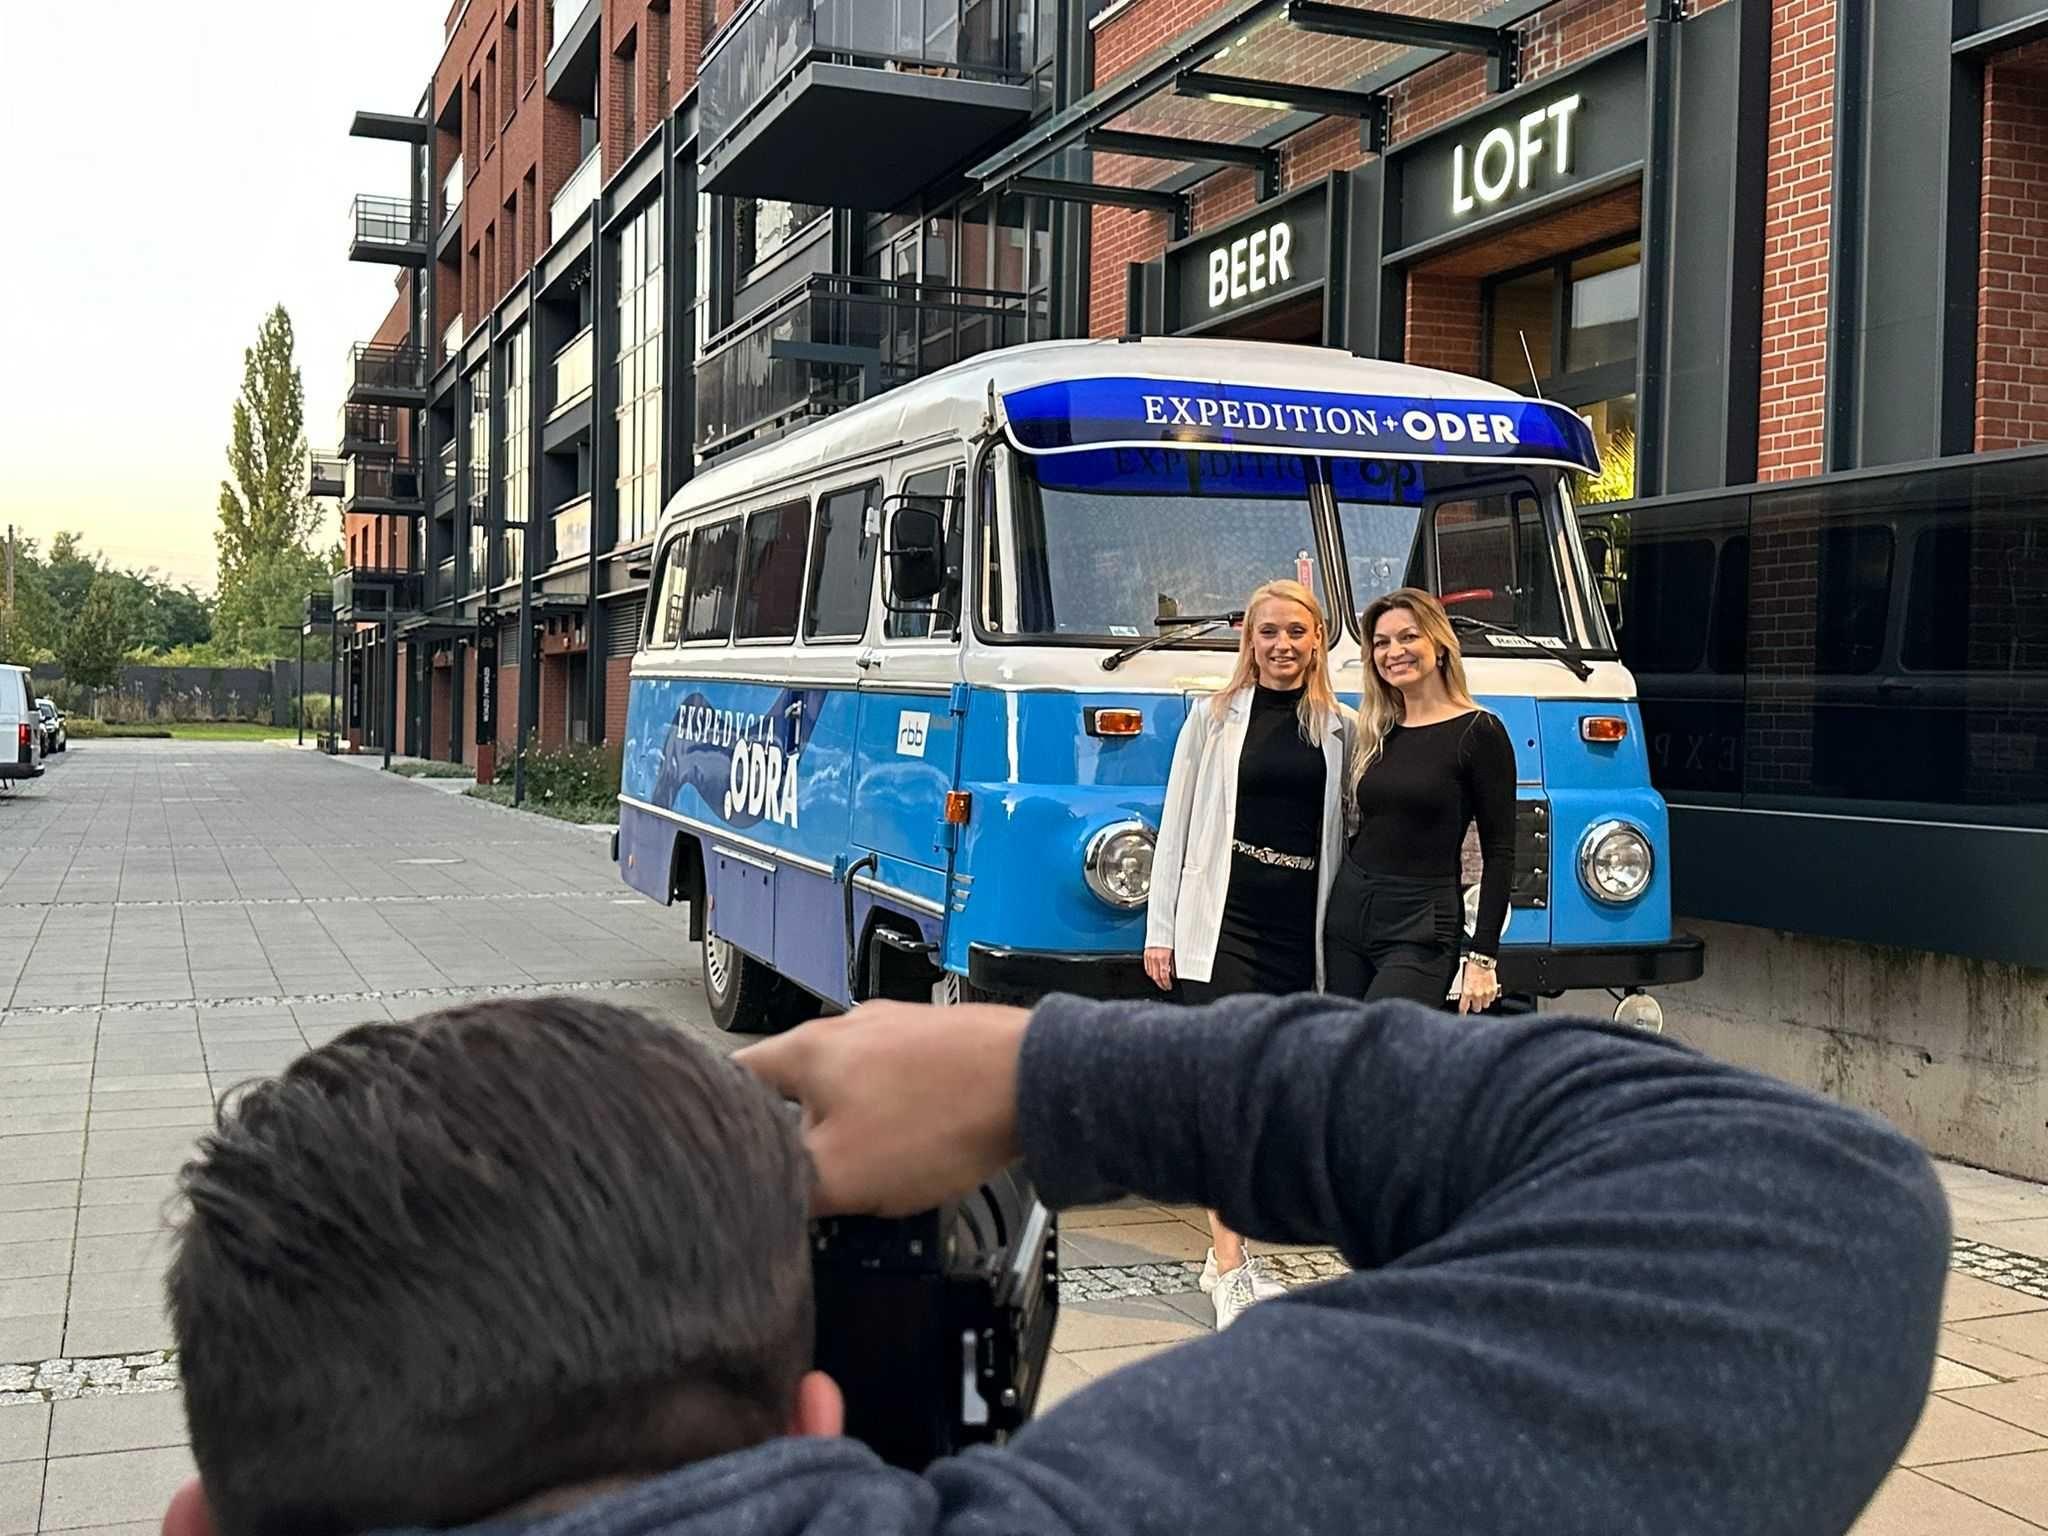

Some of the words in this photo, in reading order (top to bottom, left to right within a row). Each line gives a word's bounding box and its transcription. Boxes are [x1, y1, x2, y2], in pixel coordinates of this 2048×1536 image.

[1209, 222, 1291, 308] BEER
[1453, 94, 1581, 215] LOFT
[1142, 396, 1379, 436] EXPEDITION
[1402, 411, 1519, 444] ODER
[900, 719, 923, 746] rbb
[730, 738, 799, 829] ODRA
